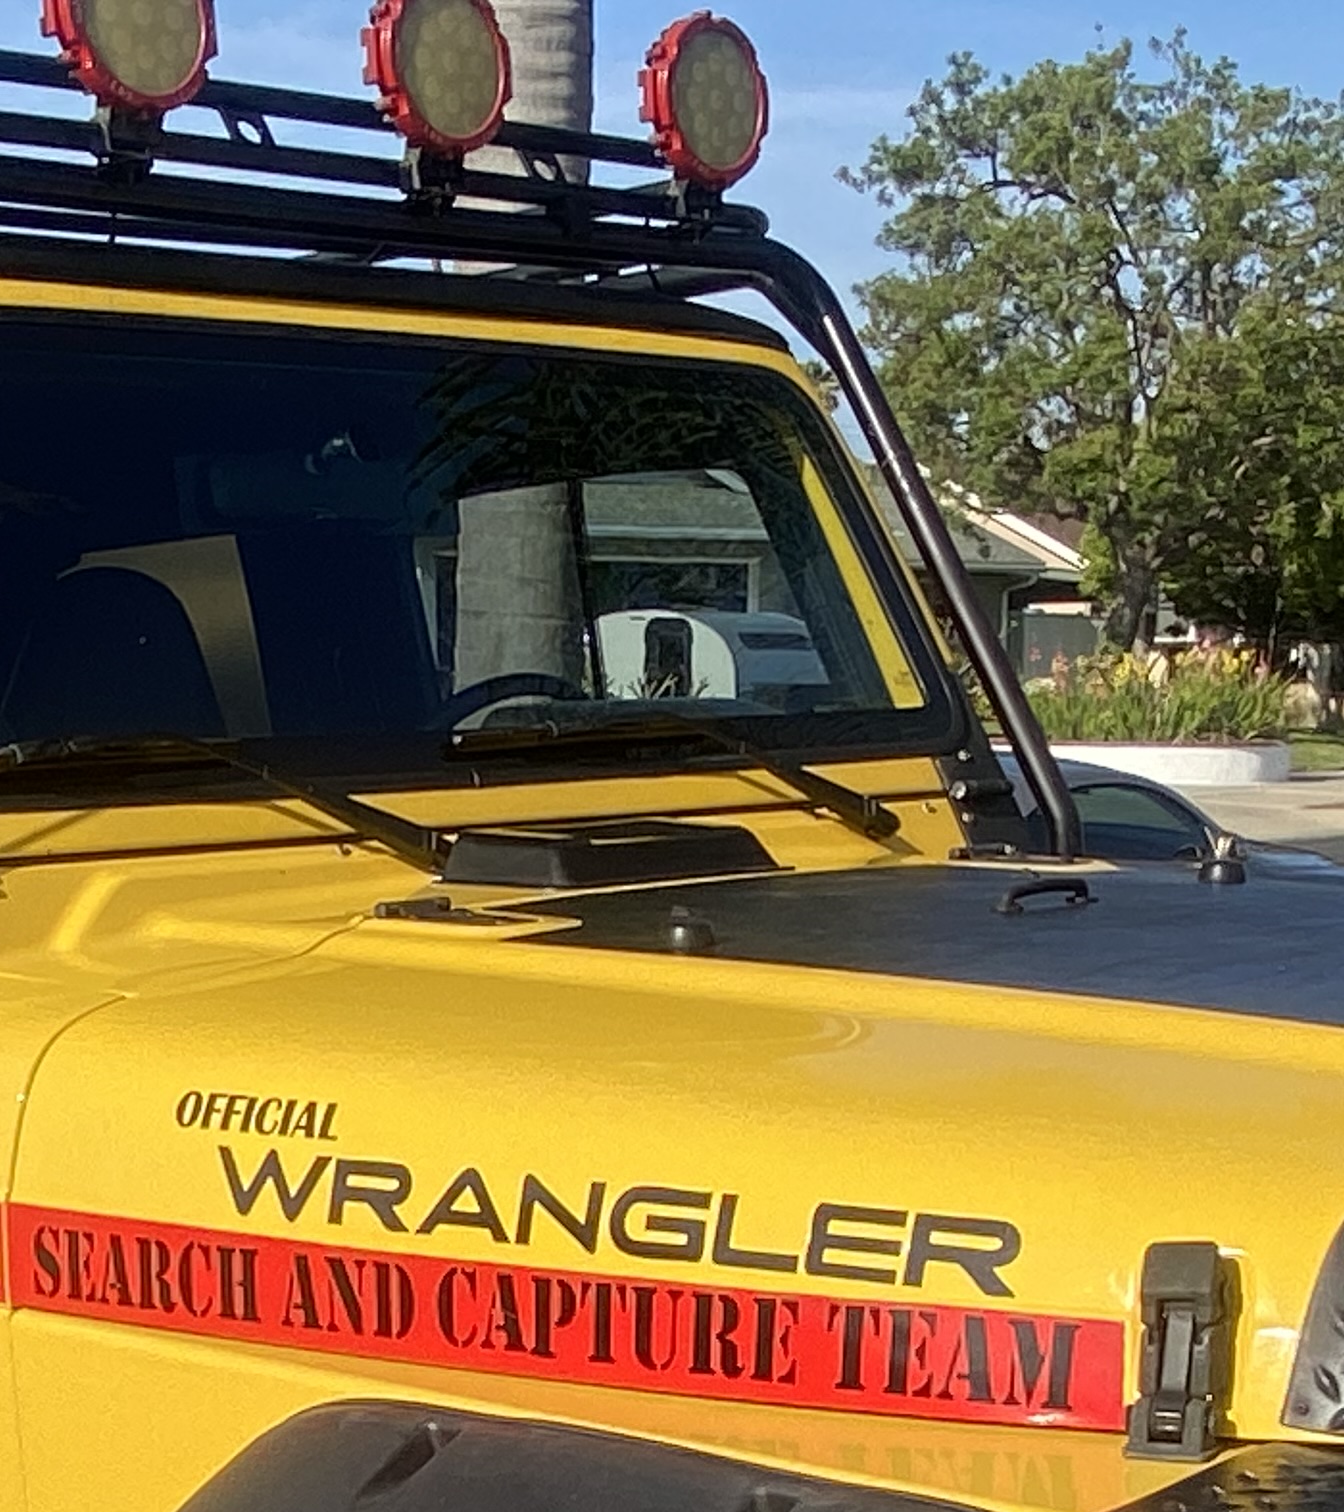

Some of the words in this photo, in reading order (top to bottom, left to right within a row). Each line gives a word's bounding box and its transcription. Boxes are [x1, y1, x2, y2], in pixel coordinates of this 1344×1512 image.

[175, 1090, 339, 1142] OFFICIAL
[217, 1144, 1023, 1299] WRANGLER
[32, 1223, 262, 1325] SEARCH
[280, 1251, 416, 1341] AND
[436, 1264, 801, 1386] CAPTURE
[825, 1301, 1081, 1412] TEAM
